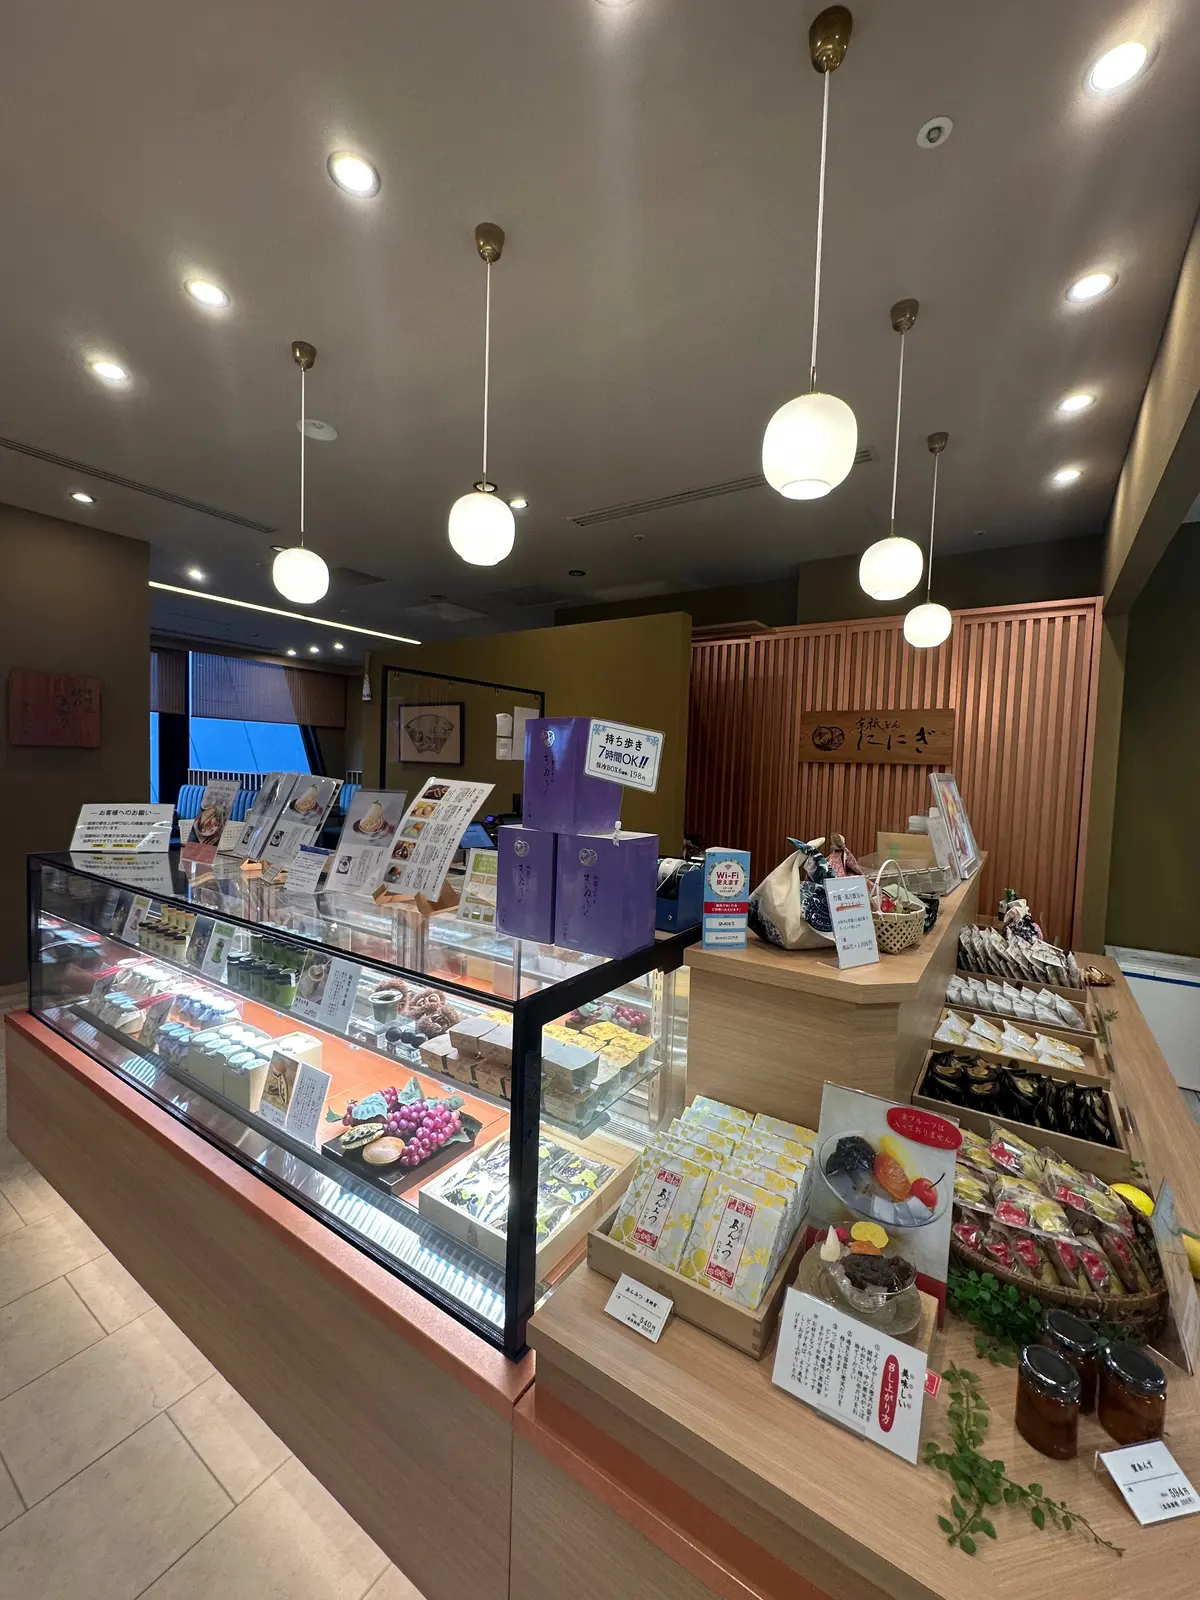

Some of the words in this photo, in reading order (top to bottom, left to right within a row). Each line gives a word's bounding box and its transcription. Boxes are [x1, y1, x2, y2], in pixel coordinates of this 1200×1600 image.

[605, 732, 643, 752] 持ち歩き
[598, 745, 650, 769] 7時間OK!!
[629, 770, 646, 781] 198円
[716, 871, 739, 880] Wi-Fi
[639, 1316, 656, 1331] 540円
[880, 1360, 897, 1426] 召し上がり方
[897, 1367, 910, 1410] 美味しい
[1168, 1486, 1191, 1498] 594円
